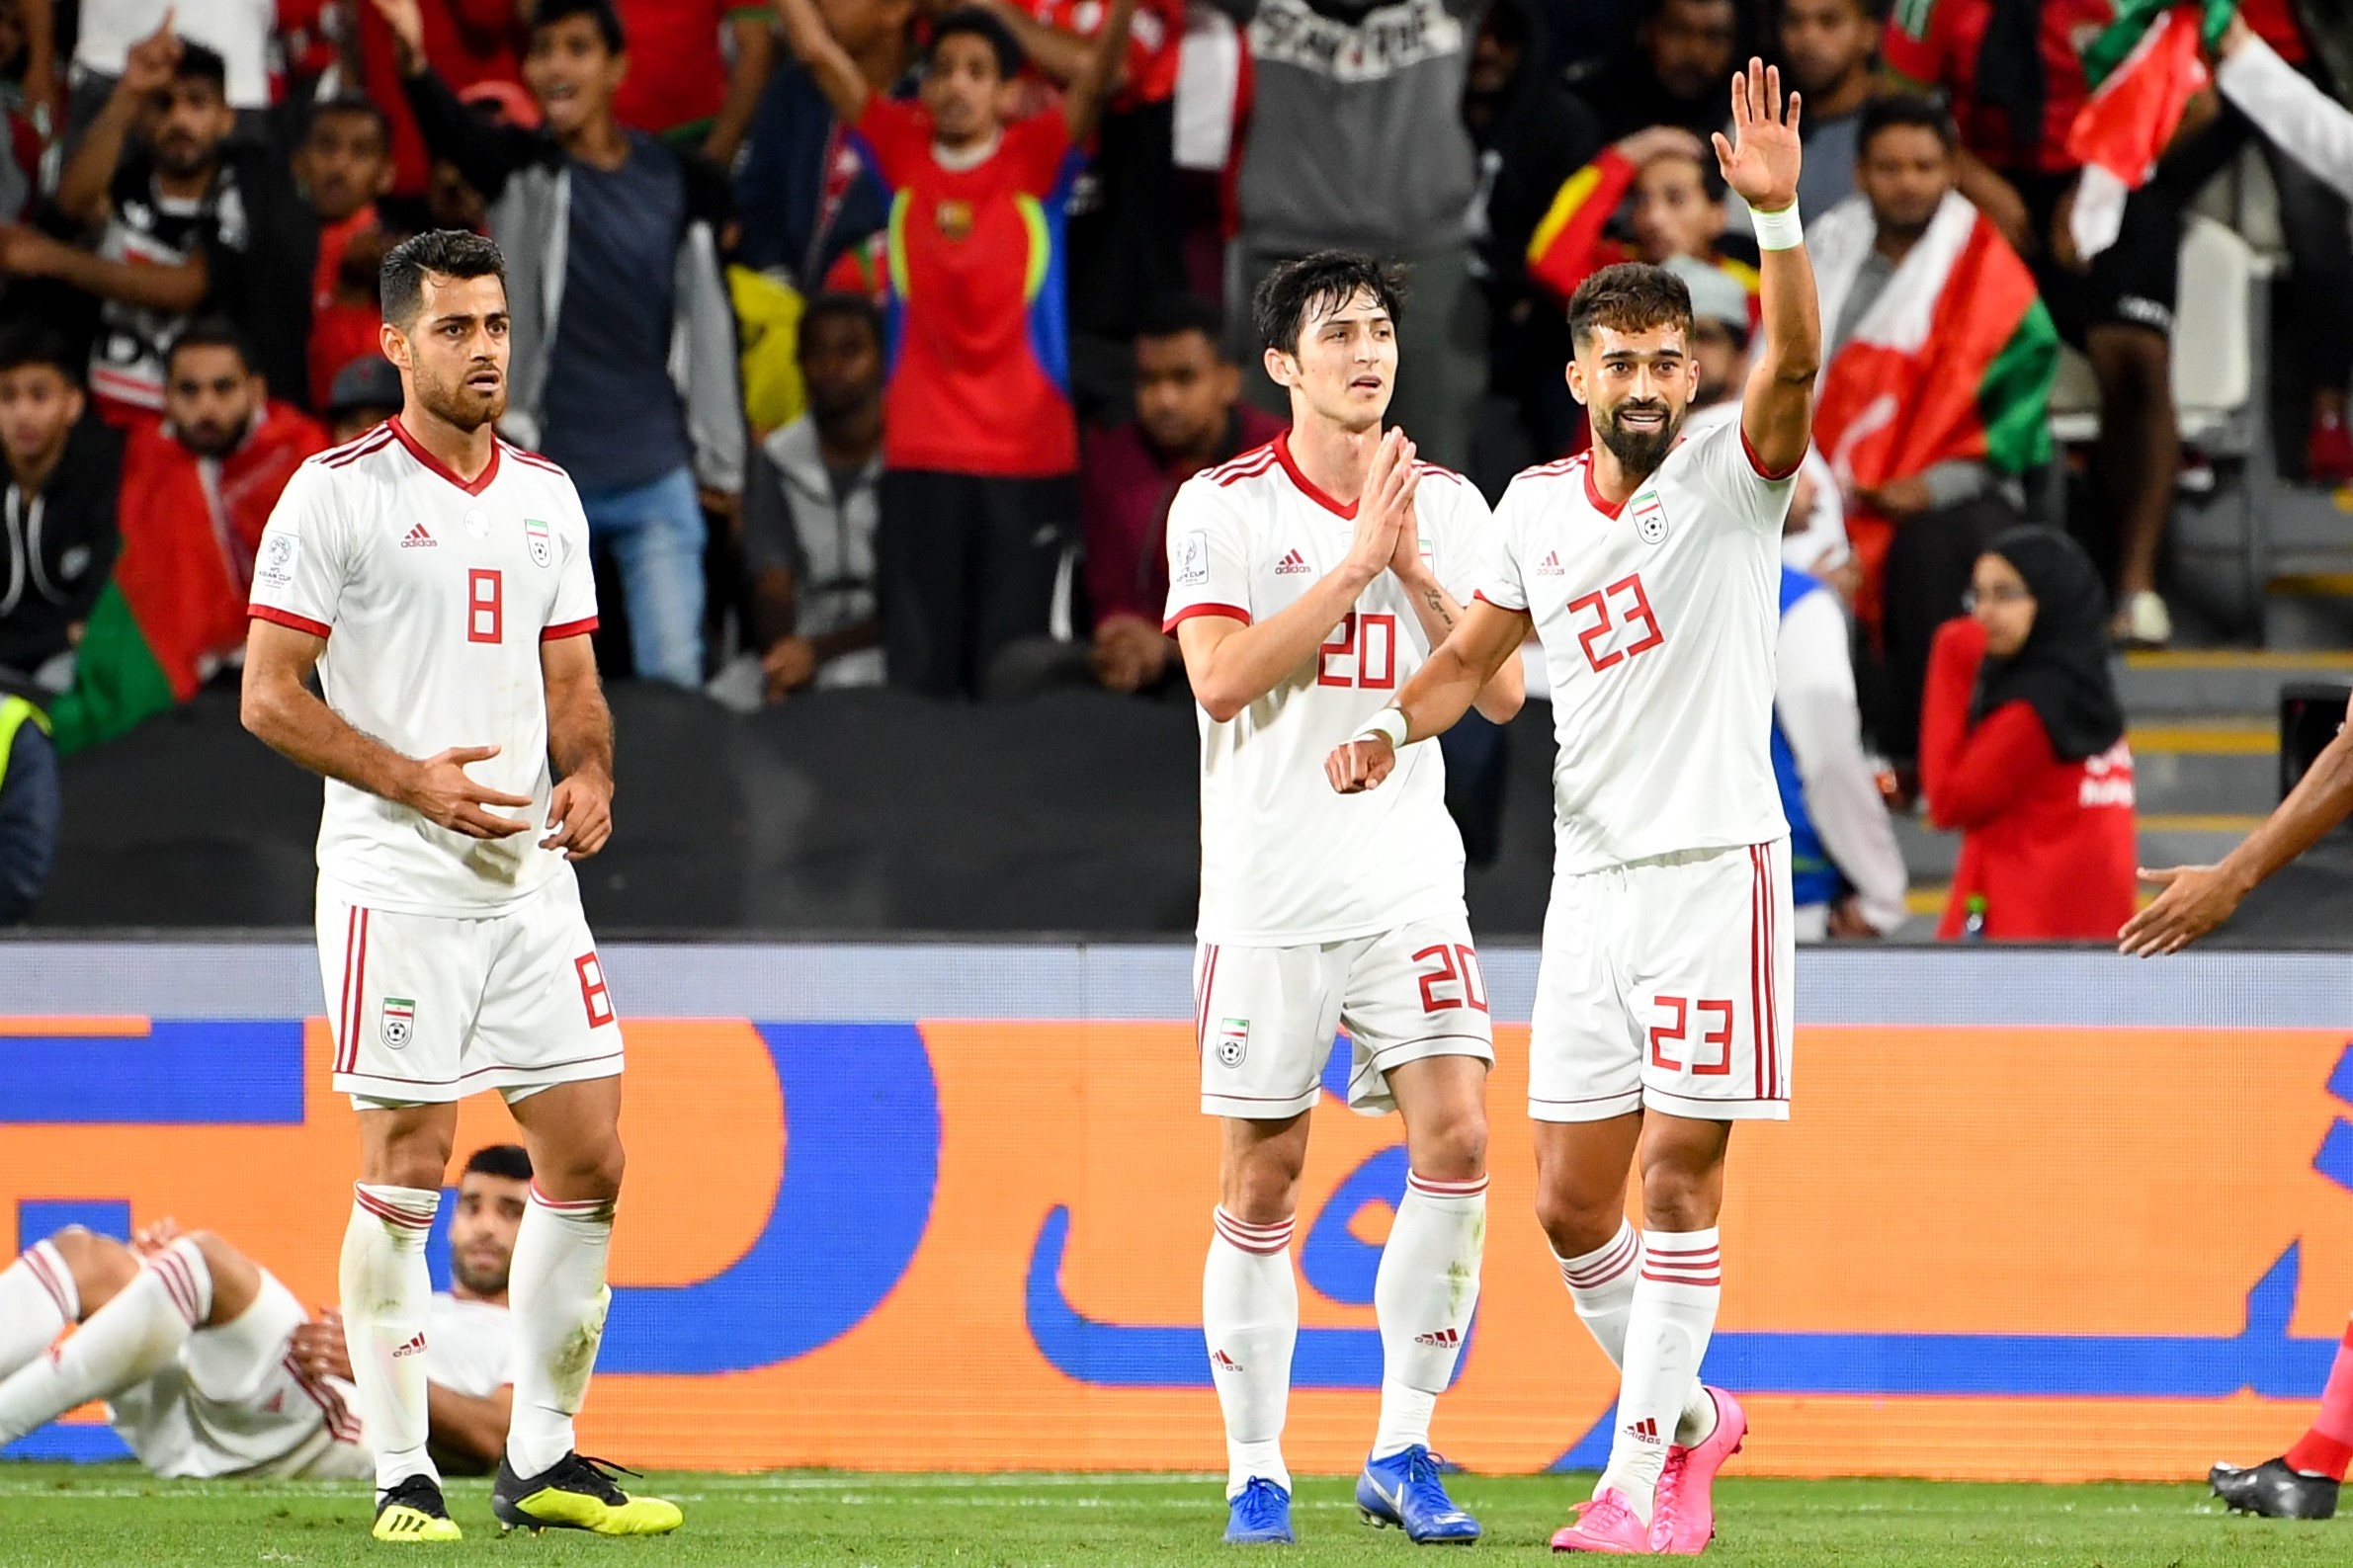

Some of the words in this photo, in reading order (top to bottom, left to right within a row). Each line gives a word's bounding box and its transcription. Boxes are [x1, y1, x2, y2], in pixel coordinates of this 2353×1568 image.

[400, 537, 438, 548] adidas
[1275, 565, 1311, 575] adidas
[467, 568, 502, 644] 8
[1566, 572, 1664, 674] 23
[1317, 612, 1395, 689] 20
[574, 951, 614, 1030] 8
[1411, 944, 1488, 1014] 20
[1649, 996, 1732, 1075] 23
